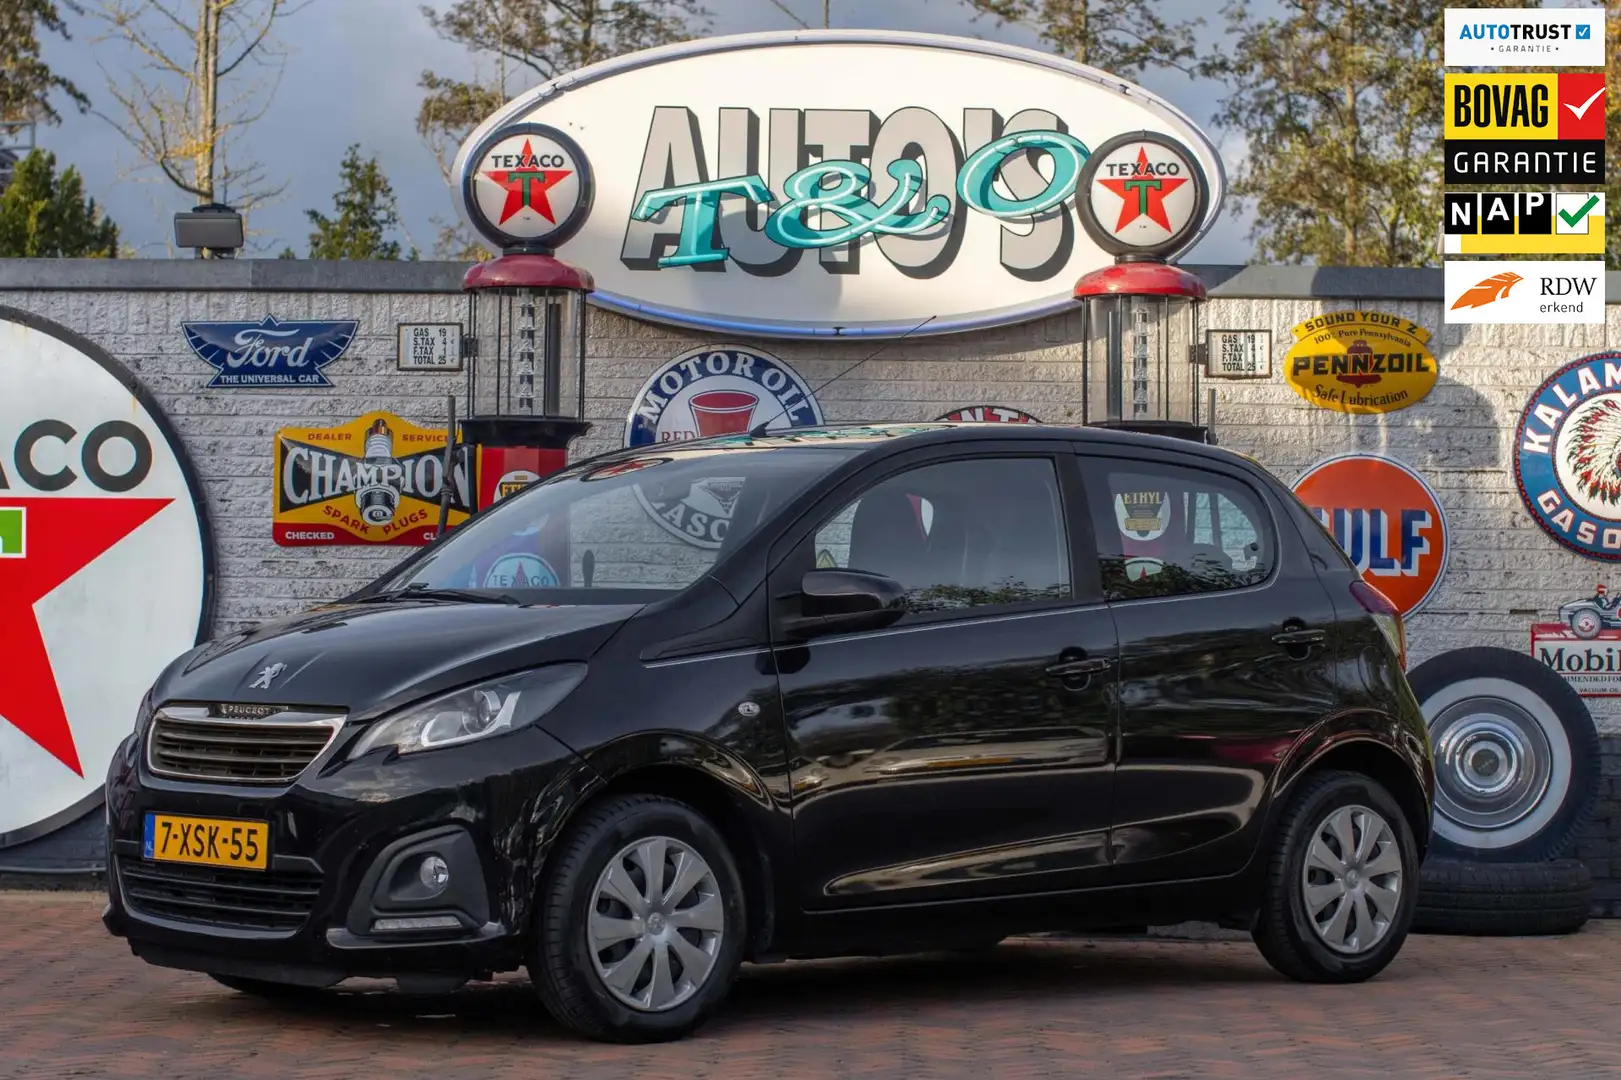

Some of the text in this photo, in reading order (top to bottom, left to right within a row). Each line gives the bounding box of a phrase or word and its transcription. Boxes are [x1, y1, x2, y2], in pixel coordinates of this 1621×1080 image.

[491, 154, 565, 168] TEXACO
[1105, 162, 1180, 176] TEXACO
[1305, 312, 1356, 333] SOUND
[1360, 311, 1400, 328] YOUR
[413, 328, 447, 337] GAS 19
[1338, 329, 1359, 338] Pure
[1360, 328, 1412, 348] Pennsylvania
[413, 337, 447, 346] S.TAX 4
[1221, 334, 1256, 344] GAS 19
[226, 328, 313, 368] Ford
[413, 346, 434, 356] F.TAX
[1221, 344, 1244, 353] S.TAX
[413, 356, 447, 365] TOTAL 25
[1222, 353, 1243, 362] F.TAX
[1222, 362, 1256, 371] TOTAL 25
[1292, 353, 1430, 377] PENNZOIL
[220, 374, 320, 384] THE UNIVERSAL CAR
[637, 351, 811, 425] MOTOR OIL
[1312, 383, 1409, 407] Safe Lubrication
[307, 432, 352, 442] DEALER
[402, 433, 450, 443] SERVIC
[0, 418, 153, 493] CO
[322, 504, 429, 536] SPARK PLUGS
[285, 531, 335, 540] CHECKED
[1310, 507, 1433, 577] ULF
[228, 704, 273, 715] PEUGEOT
[161, 821, 260, 862] 7-XSK-55
